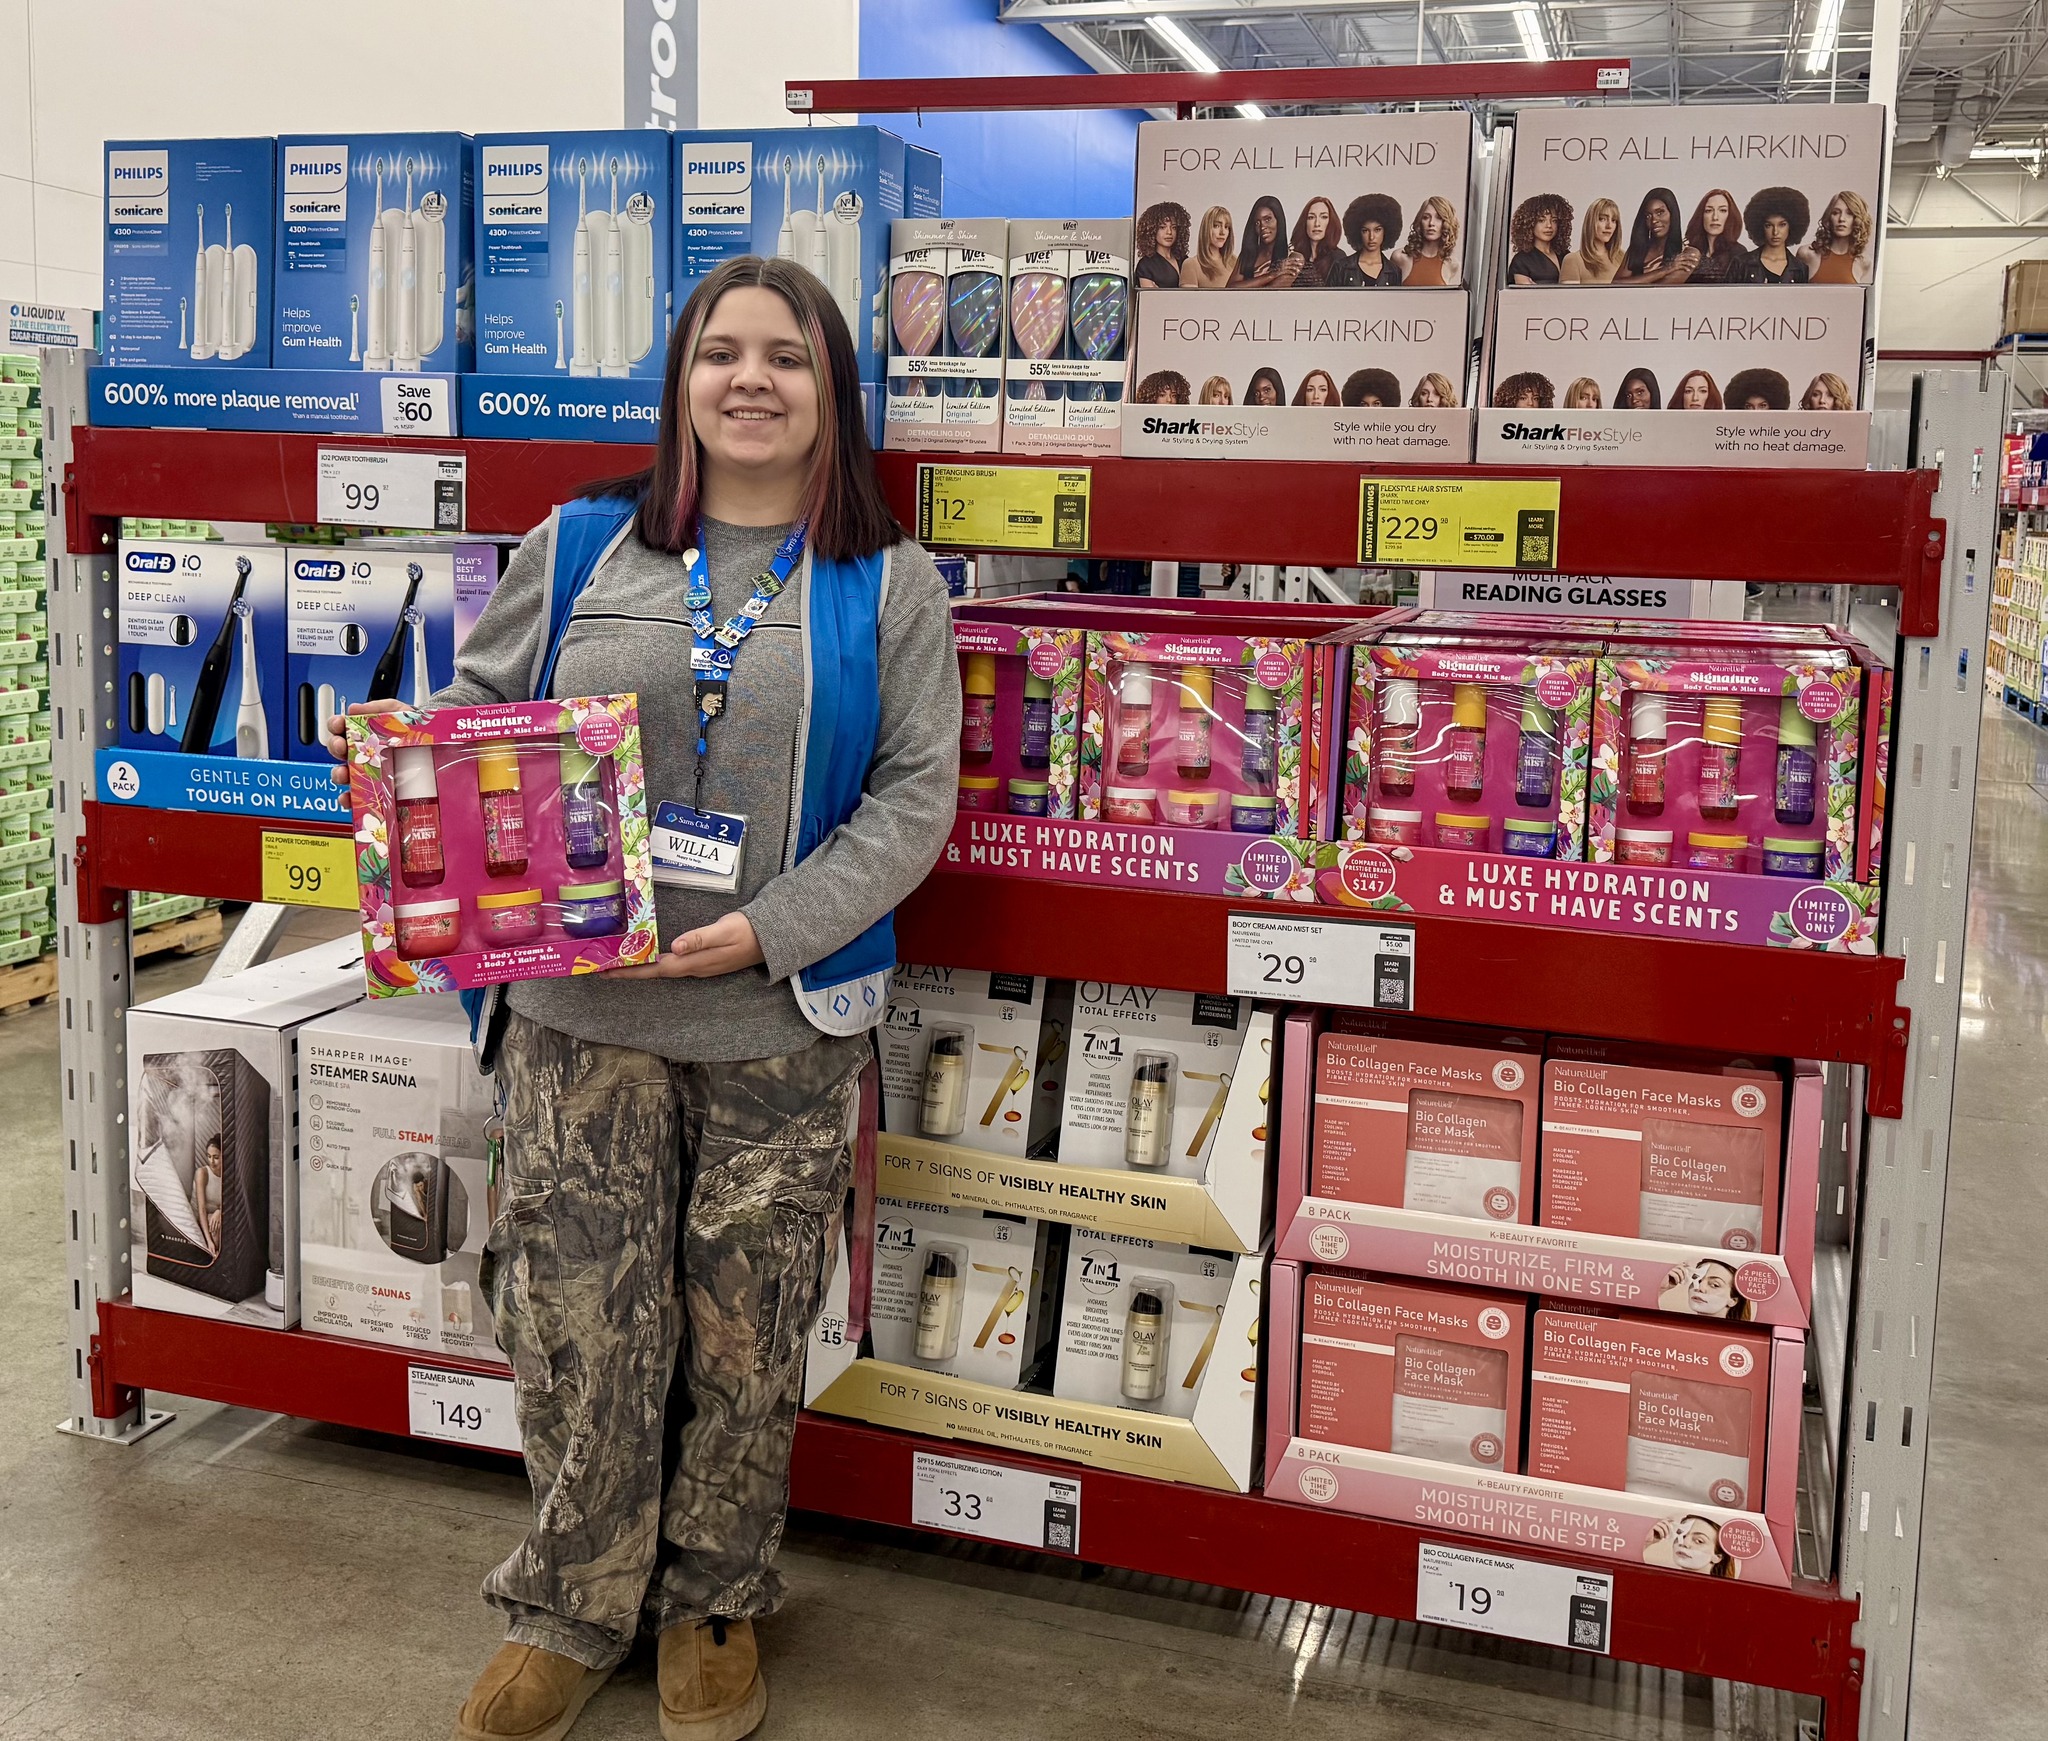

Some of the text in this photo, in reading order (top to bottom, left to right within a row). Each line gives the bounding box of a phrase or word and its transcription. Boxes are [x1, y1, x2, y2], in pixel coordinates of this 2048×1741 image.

[1543, 134, 1846, 162] FOR ALL HAIRKIND
[1163, 142, 1436, 172] FOR ALL HAIRKIND
[114, 167, 163, 180] PHILIPS
[290, 163, 341, 176] PHILIPS
[488, 162, 543, 177] PHILIPS
[688, 160, 745, 176] PHILIPS
[114, 205, 163, 217] sonicare
[290, 202, 341, 214] sonicare
[488, 203, 543, 216] sonicare
[688, 203, 745, 216] sonicare
[21, 306, 54, 320] LIQUID
[283, 307, 310, 320] Helps
[283, 322, 321, 335] improve
[1163, 318, 1434, 342] FOR ALL HAIRKIND
[1525, 317, 1827, 341] FOR ALL HAIRKIND
[45, 334, 77, 346] HYDRATION
[282, 336, 342, 348] Gum Health
[908, 360, 928, 373] 55%
[1029, 364, 1050, 376] 55%
[104, 383, 167, 405] 600%
[174, 391, 217, 406] more
[222, 389, 281, 411] plaque
[398, 384, 431, 398] Save
[398, 402, 432, 422] $60
[479, 392, 661, 423] 600% more plaqu
[907, 429, 971, 438] DETANGLING DUO
[1334, 422, 1437, 436] Style while you dry
[1028, 433, 1096, 442] DETANGLING DUO
[1162, 437, 1171, 445] Air
[1173, 438, 1195, 446] Styling
[1202, 438, 1223, 446] Drying
[1225, 438, 1249, 446] System
[1334, 435, 1451, 449] with no heat damage.
[352, 456, 388, 464] TOOTHBRUSH
[1381, 485, 1416, 493] FLEXSTYLE
[922, 504, 930, 537] INSTANT
[129, 556, 171, 571] Oral-B
[128, 592, 186, 603] DEEP CLEAN
[1462, 583, 1666, 608] READING GLASSES
[456, 715, 532, 730] Signature
[450, 731, 471, 740] Body
[474, 730, 501, 738] Cream
[513, 727, 531, 735] Mist
[118, 767, 128, 781] 2
[190, 768, 343, 794] GENTLE ON GUMS,
[113, 781, 136, 792] PACK
[186, 788, 245, 806] TOUGH
[252, 792, 277, 808] ON
[971, 822, 1174, 856] LUXE HYDRATION
[669, 836, 720, 861] WILLA
[947, 843, 1199, 882] & MUST HAVE SCENTS
[1248, 853, 1288, 864] LIMITED
[1255, 863, 1280, 873] TIME
[1255, 873, 1280, 883] ONLY
[1468, 862, 1710, 901] LUXE HYDRATION
[1352, 879, 1384, 893] $147
[1439, 885, 1739, 932] & MUST HAVE SCENTS
[1252, 922, 1276, 930] CREAM
[1293, 925, 1310, 933] MIST
[1078, 1005, 1157, 1022] TOTAL EFFECTS
[310, 1046, 364, 1063] SHARPER
[1327, 1054, 1482, 1082] Bio Collagen Face Masks
[310, 1063, 416, 1088] STEAMER SAUNA
[398, 1130, 433, 1144] STEAM
[884, 1154, 1167, 1211] FOR 7 SIGNS OF VISIBLY HEALTHY SKIN
[1308, 1206, 1351, 1221] 8 PACK
[1433, 1241, 1635, 1281] MOISTURIZE, FIRM &
[1427, 1259, 1641, 1300] SMOOTH IN ONE STEP
[371, 1285, 411, 1300] SAUNAS
